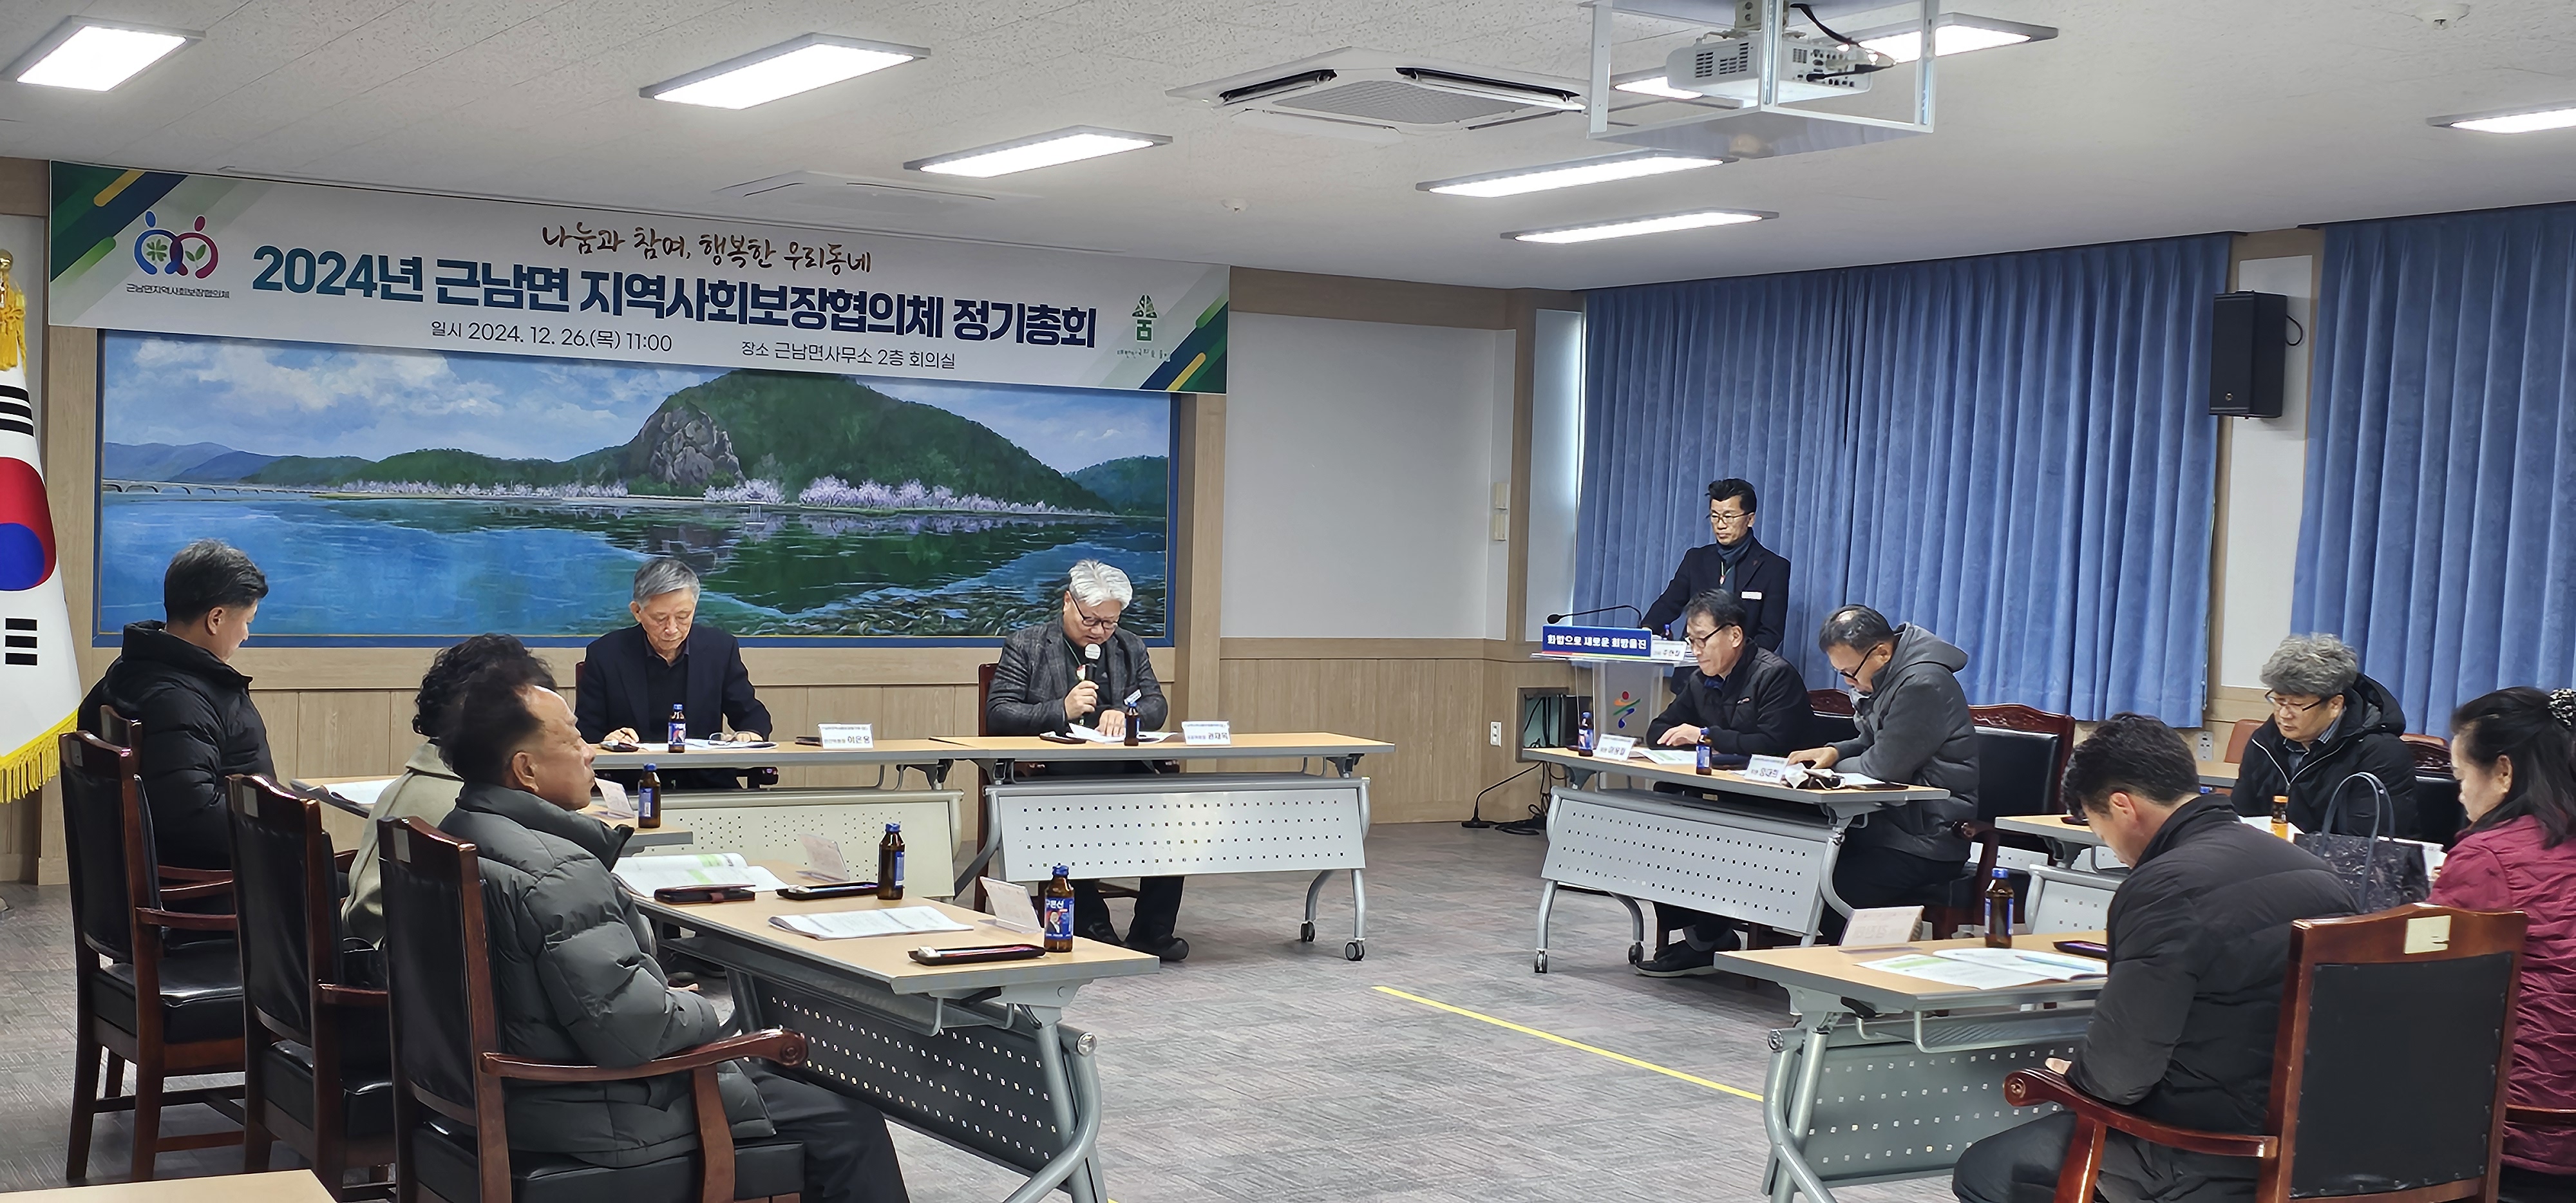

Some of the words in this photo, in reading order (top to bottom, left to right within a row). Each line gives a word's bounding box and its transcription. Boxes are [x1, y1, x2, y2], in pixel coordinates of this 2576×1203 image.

[542, 222, 625, 255] 나눔과
[634, 227, 692, 260] 참여,
[699, 234, 777, 269] 행복한
[784, 242, 872, 275] 우리동네
[252, 244, 424, 303] 2024년
[434, 258, 570, 312] 근남면
[579, 270, 945, 339] 지역사회보장협의체
[951, 296, 1097, 349] 정기총회
[431, 321, 462, 338] 일시
[468, 322, 524, 344] 2024.
[530, 327, 556, 345] 12.
[561, 327, 621, 350] 26.(목)
[627, 332, 673, 352] 11:00
[741, 341, 770, 358] 장소
[775, 341, 873, 365] 근남면사무소
[878, 348, 904, 367] 2층
[909, 350, 956, 370] 회의실
[1547, 634, 1582, 646] 화합으로
[1584, 636, 1610, 647] 새로운
